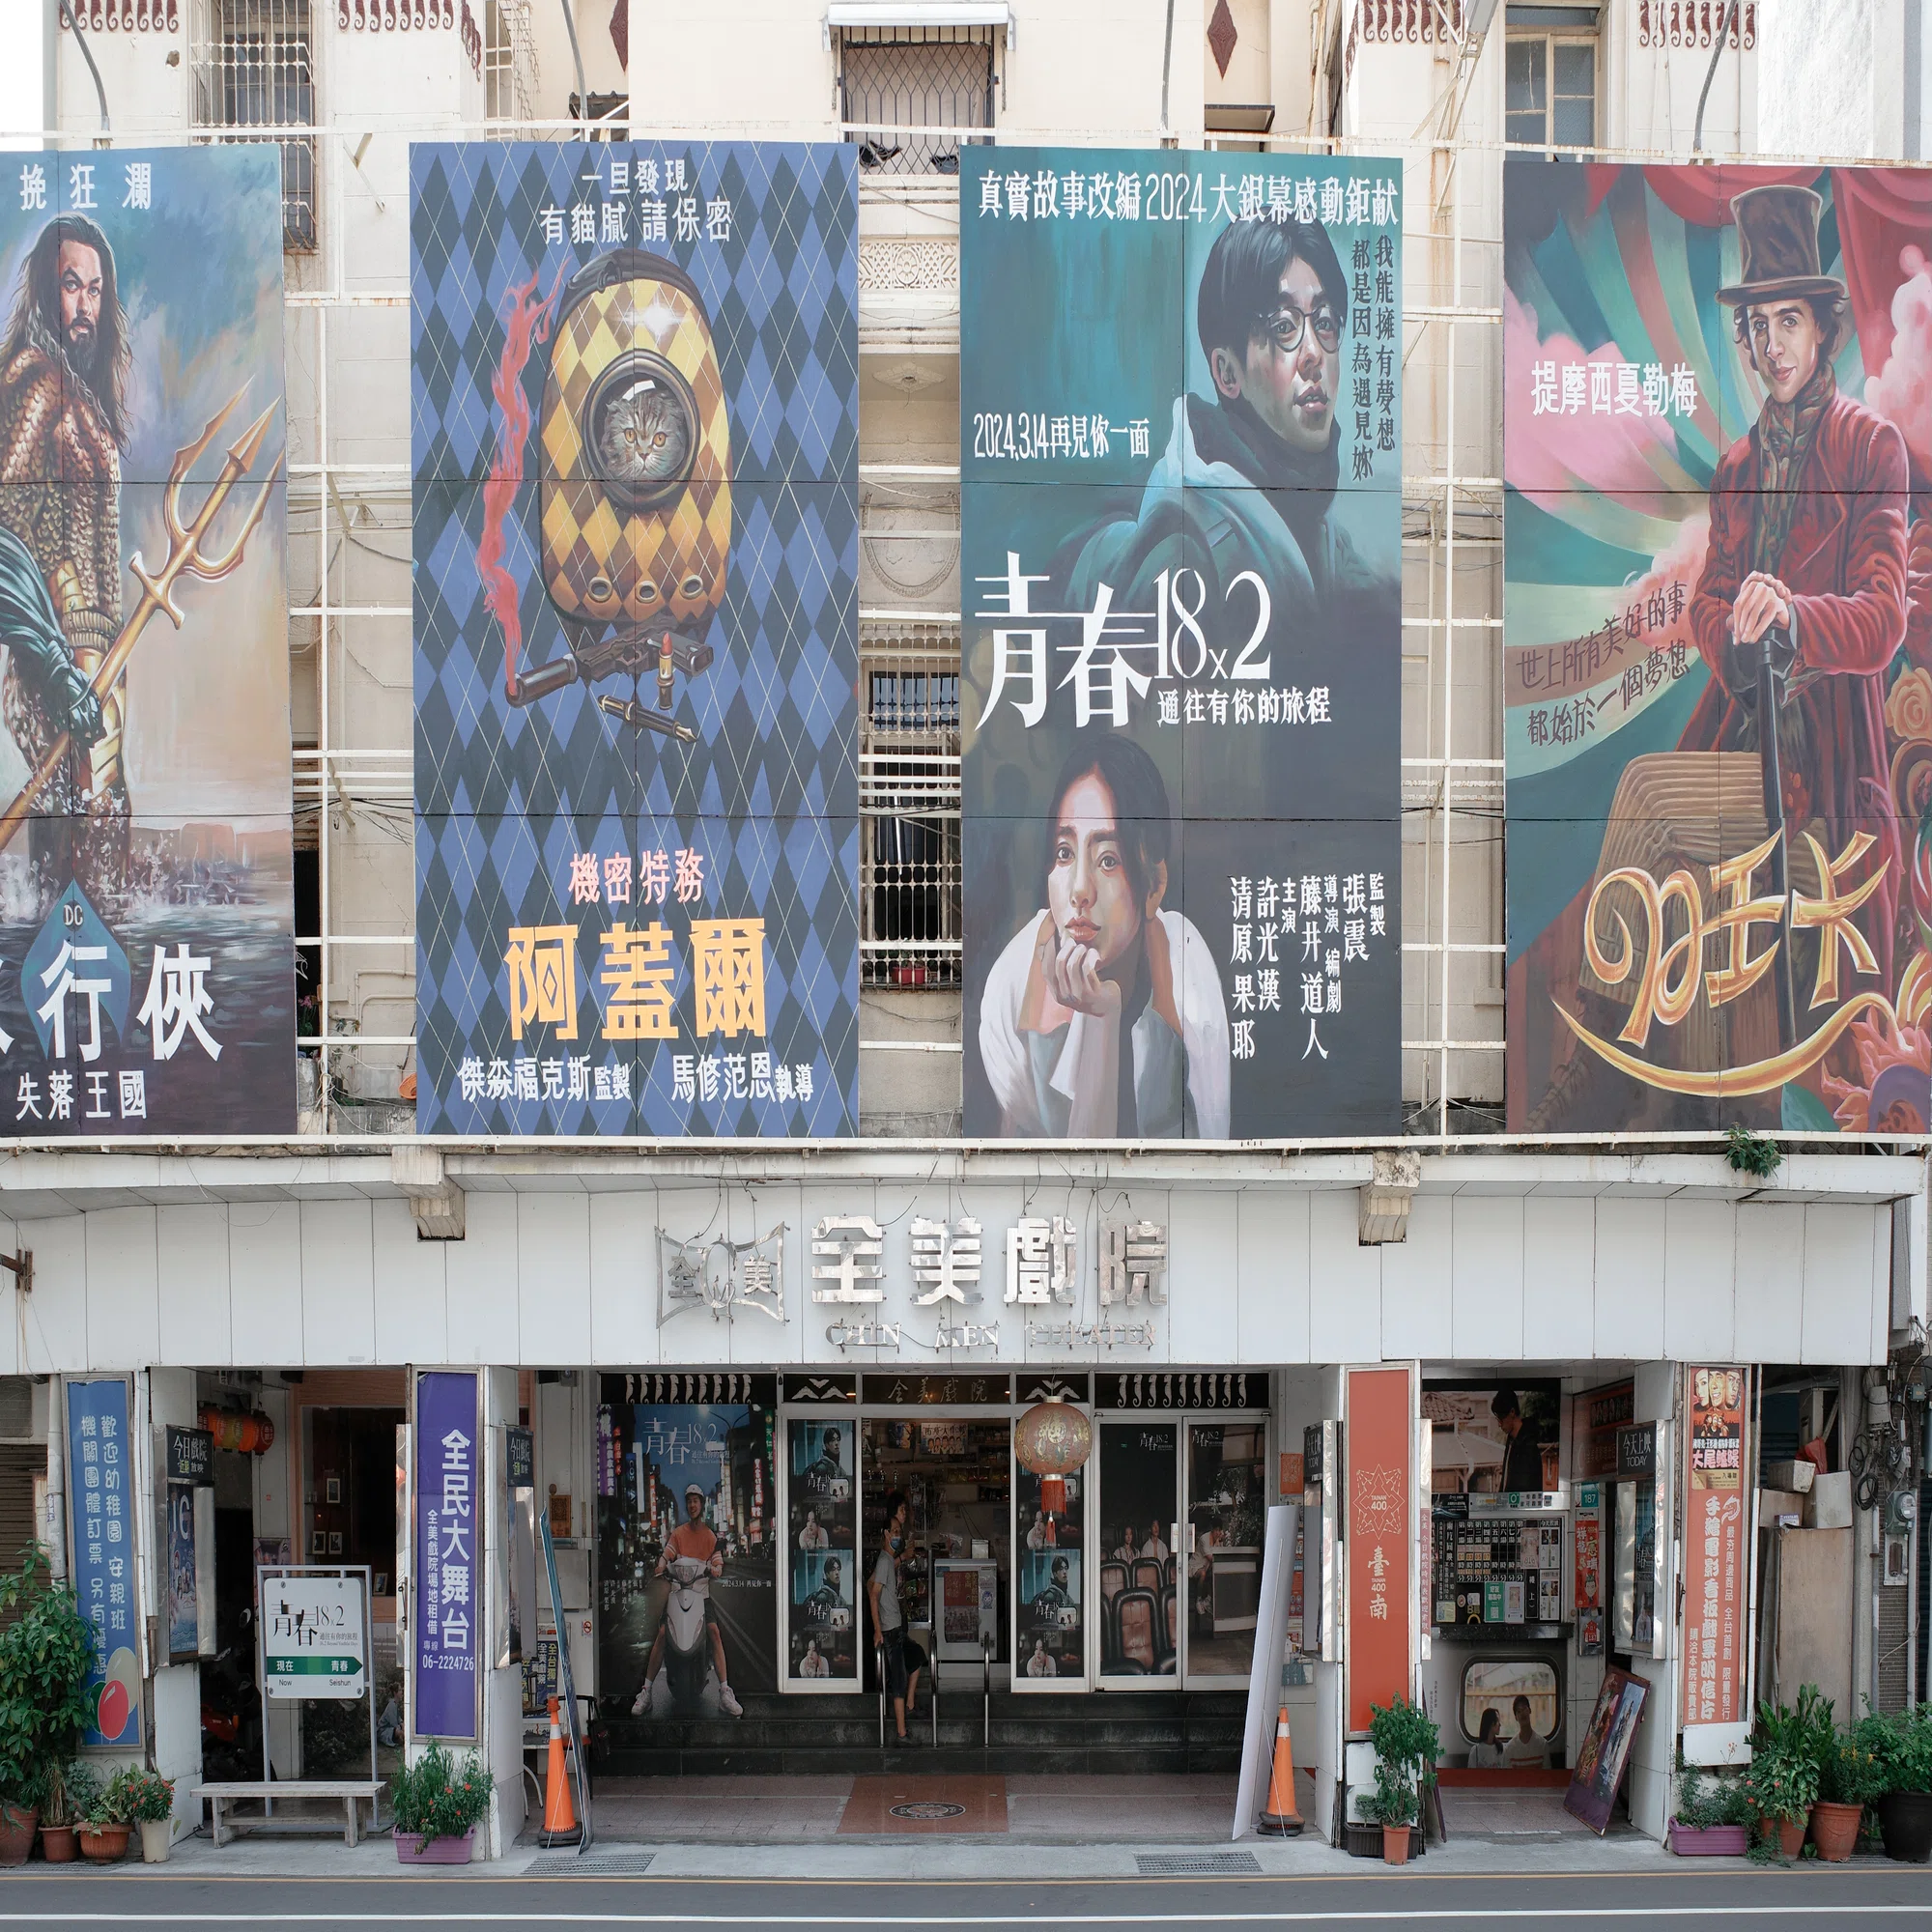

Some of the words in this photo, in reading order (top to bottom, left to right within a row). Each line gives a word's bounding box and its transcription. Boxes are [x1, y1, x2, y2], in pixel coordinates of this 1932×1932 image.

[19, 162, 152, 212] 挽狂瀾
[582, 159, 688, 194] 一旦發現
[540, 200, 628, 244] 有貓膩
[641, 195, 732, 242] 請保密
[1350, 240, 1374, 482] 都是因為遇見妳
[1374, 235, 1396, 452] 我能擁有夢想
[1531, 360, 1697, 417] 提摩西夏勒梅
[1517, 580, 1688, 690] 世上所有美好的事
[1157, 687, 1332, 725] 通往有你的旅程
[1527, 639, 1691, 747] 都始於一個夢想
[568, 847, 704, 905] 機密特務
[1324, 874, 1340, 933] 導演
[1370, 872, 1386, 936] 監製
[63, 904, 84, 926] DC
[1281, 877, 1297, 933] 主演
[1343, 873, 1370, 962] 張震
[1230, 876, 1256, 1060] 清原果耶
[1256, 875, 1281, 1011] 許光漢
[1299, 875, 1329, 1061] 藤井道人
[0, 939, 223, 1063] 行俠
[1324, 948, 1342, 1013] 編劇
[15, 1069, 147, 1121] 失落王國
[825, 1322, 902, 1347] CHIN
[934, 1321, 1000, 1349] MEN
[1025, 1322, 1157, 1348] THEATER
[1623, 1431, 1651, 1456] 今天上映
[1627, 1456, 1647, 1467] TODAY
[81, 1415, 102, 1564] 機關團體訂票
[100, 1415, 123, 1543] 歡迎幼稚園
[1372, 1501, 1386, 1511] 400
[1584, 1493, 1596, 1503] 187
[441, 1429, 470, 1650] 全民大舞台
[1367, 1546, 1390, 1577] 臺
[108, 1556, 127, 1630] 安親班
[427, 1509, 439, 1635] 全美戲院場地租借
[1372, 1583, 1385, 1592] 400
[1370, 1593, 1387, 1620] 南
[276, 1661, 294, 1671] 現在
[331, 1661, 348, 1671] 青春
[422, 1655, 474, 1671] 06-2224726
